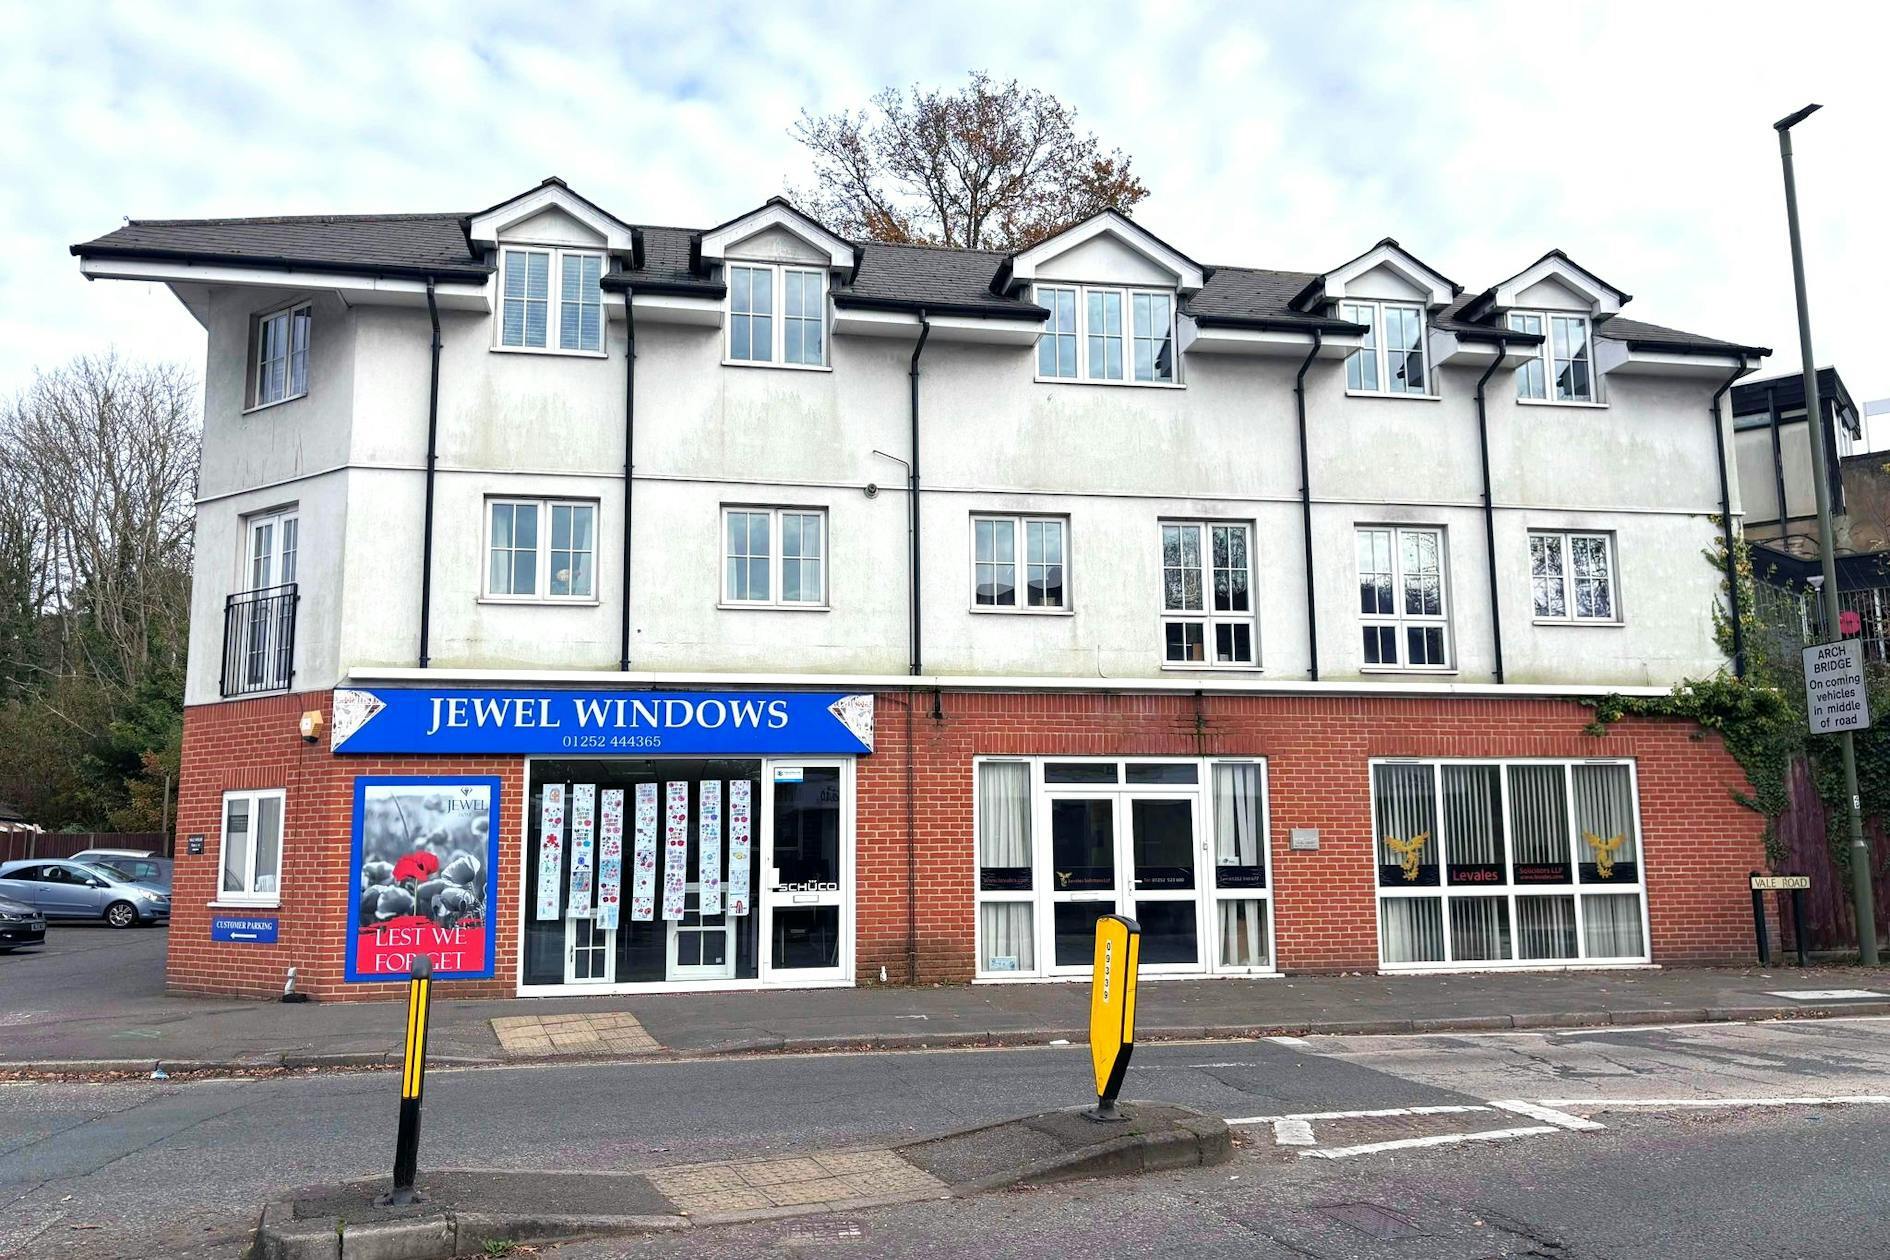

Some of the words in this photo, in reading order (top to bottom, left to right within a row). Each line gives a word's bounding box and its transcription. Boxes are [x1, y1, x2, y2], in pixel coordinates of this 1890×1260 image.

[1818, 646, 1846, 660] ARCH
[1814, 658, 1852, 673] BRIDGE
[1809, 680, 1823, 690] On
[1825, 674, 1860, 688] coming
[1817, 688, 1855, 702] vehicles
[1814, 706, 1823, 715] in
[1827, 701, 1861, 714] middle
[427, 697, 561, 735] JEWEL
[572, 699, 789, 730] WINDOWS
[1820, 717, 1830, 728] of
[1835, 714, 1857, 727] road
[562, 735, 606, 748] 01252
[610, 735, 662, 748] 444365
[447, 799, 489, 813] JEWEL
[1453, 868, 1498, 881] Levales
[778, 880, 837, 892] SCHÜCO
[1755, 878, 1776, 888] VALE
[1782, 878, 1807, 888] ROAD
[216, 920, 247, 929] CUSTOMER
[247, 921, 273, 930] PARKING
[375, 927, 426, 947] LEST
[432, 927, 468, 945] WE
